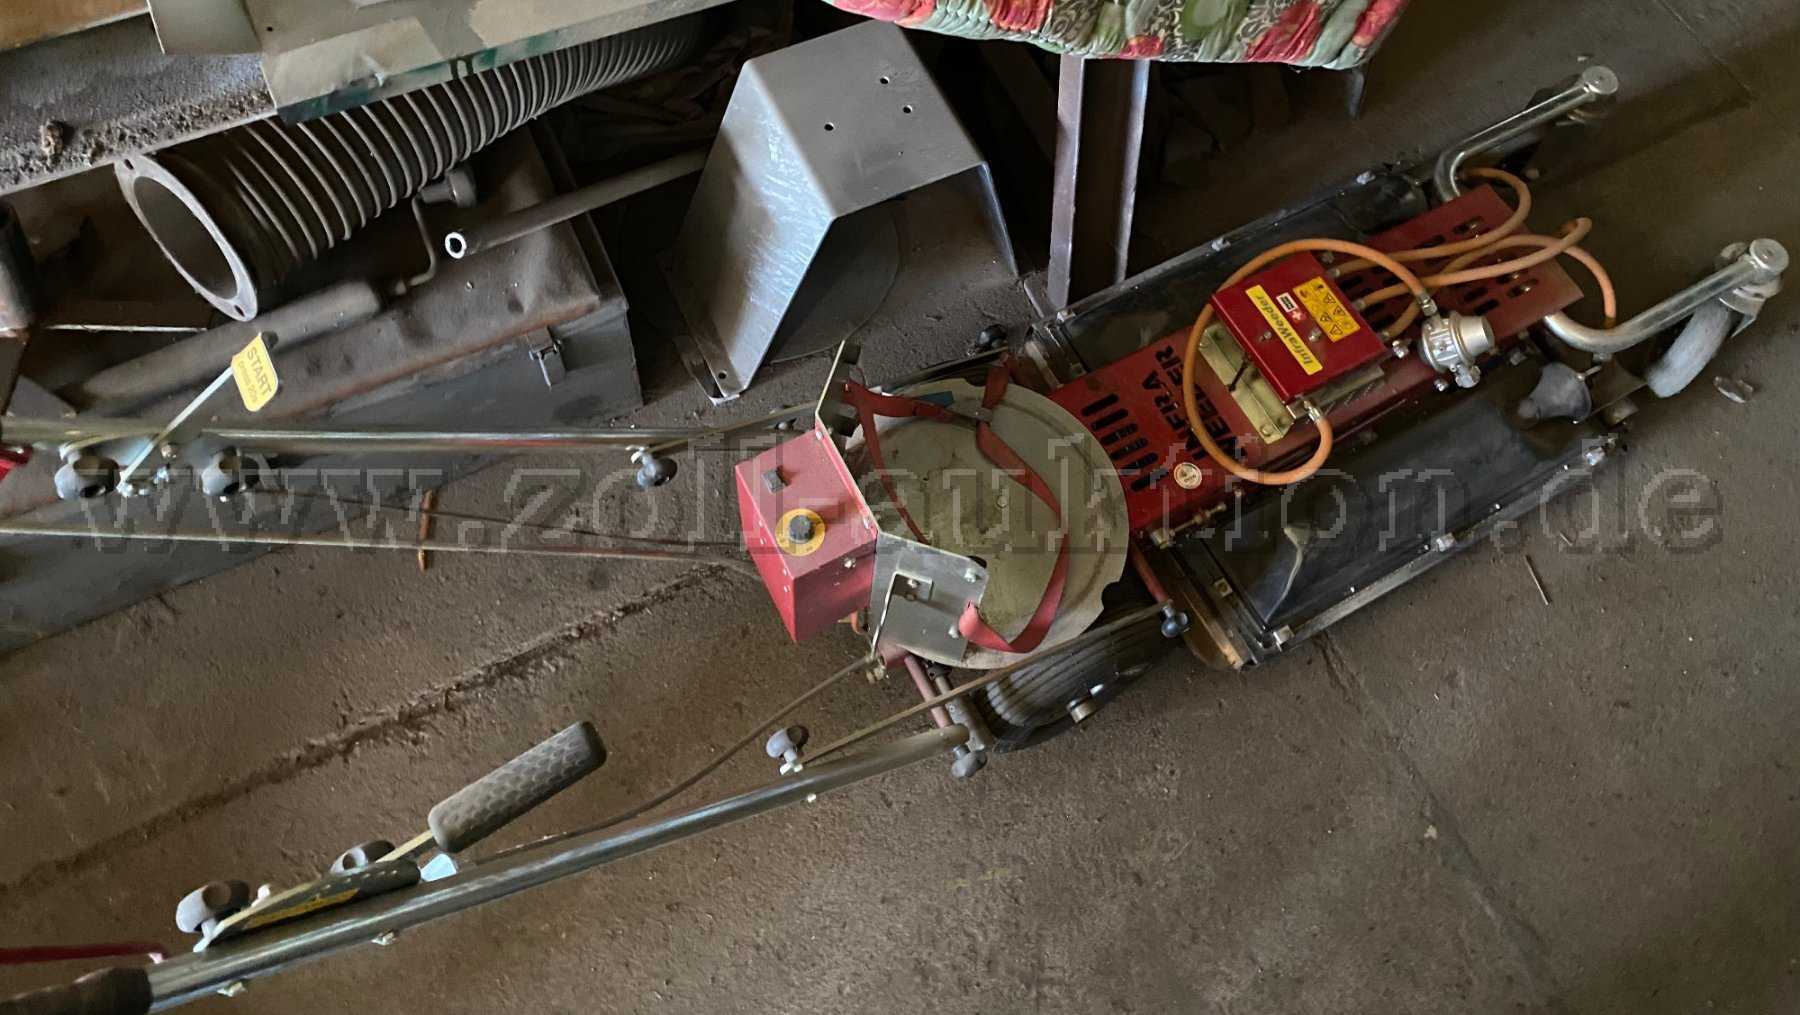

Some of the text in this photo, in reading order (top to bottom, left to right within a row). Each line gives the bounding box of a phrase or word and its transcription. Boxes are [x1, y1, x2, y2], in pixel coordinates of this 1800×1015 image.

[1254, 295, 1313, 366] InfraWeeder
[247, 346, 273, 396] START
[1142, 369, 1207, 461] INFRA
